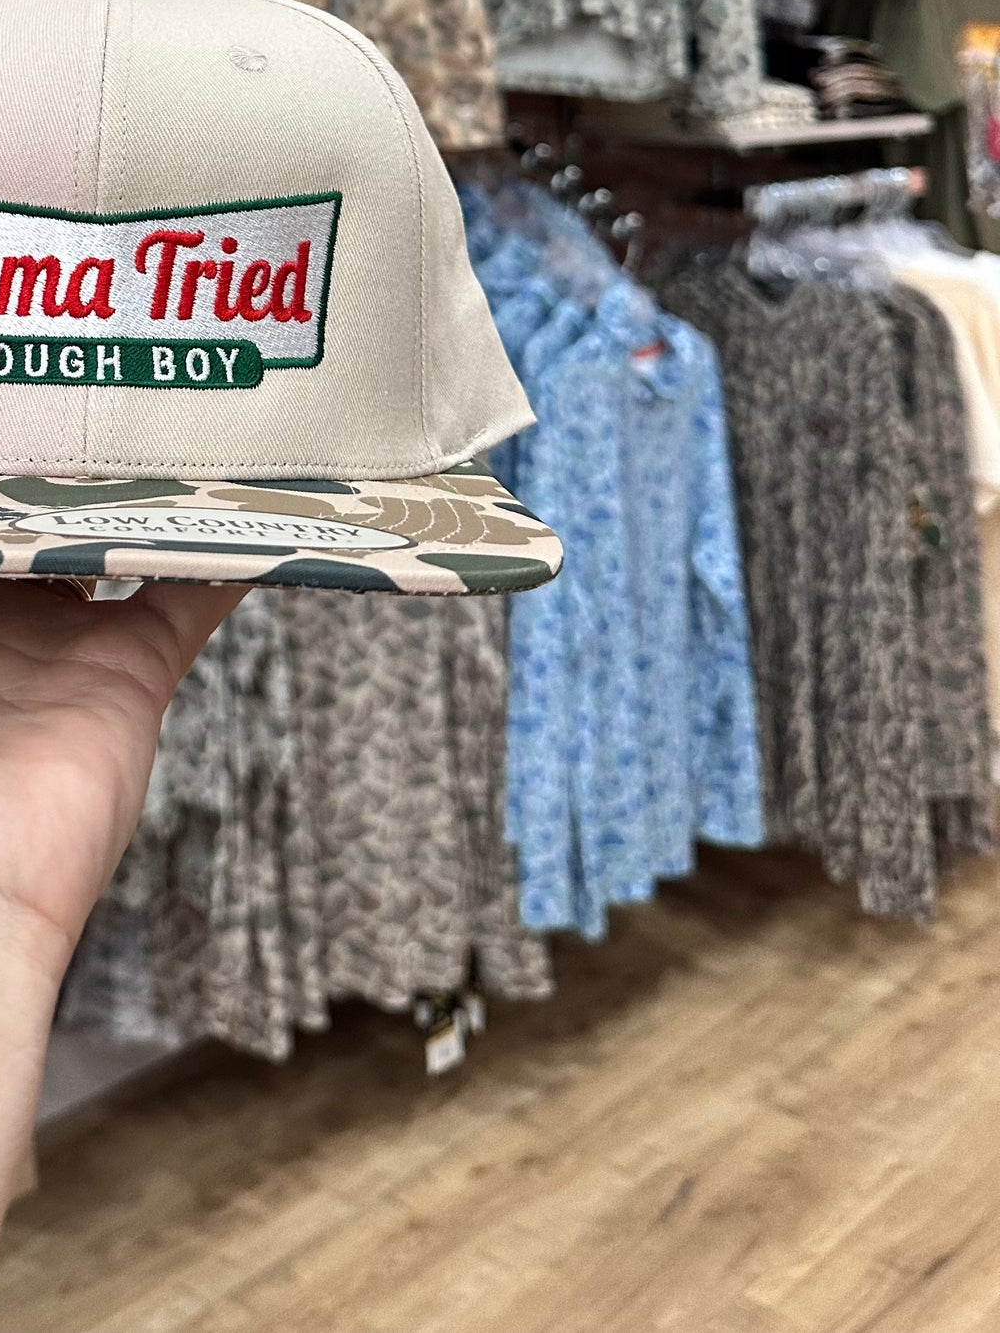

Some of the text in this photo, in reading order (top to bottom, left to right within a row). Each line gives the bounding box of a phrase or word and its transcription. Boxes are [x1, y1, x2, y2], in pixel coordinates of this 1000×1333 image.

[135, 228, 313, 323] Tried
[153, 346, 240, 383] BOY
[51, 515, 360, 537] LOW COUNTRY
[88, 525, 269, 538] COMFORT
